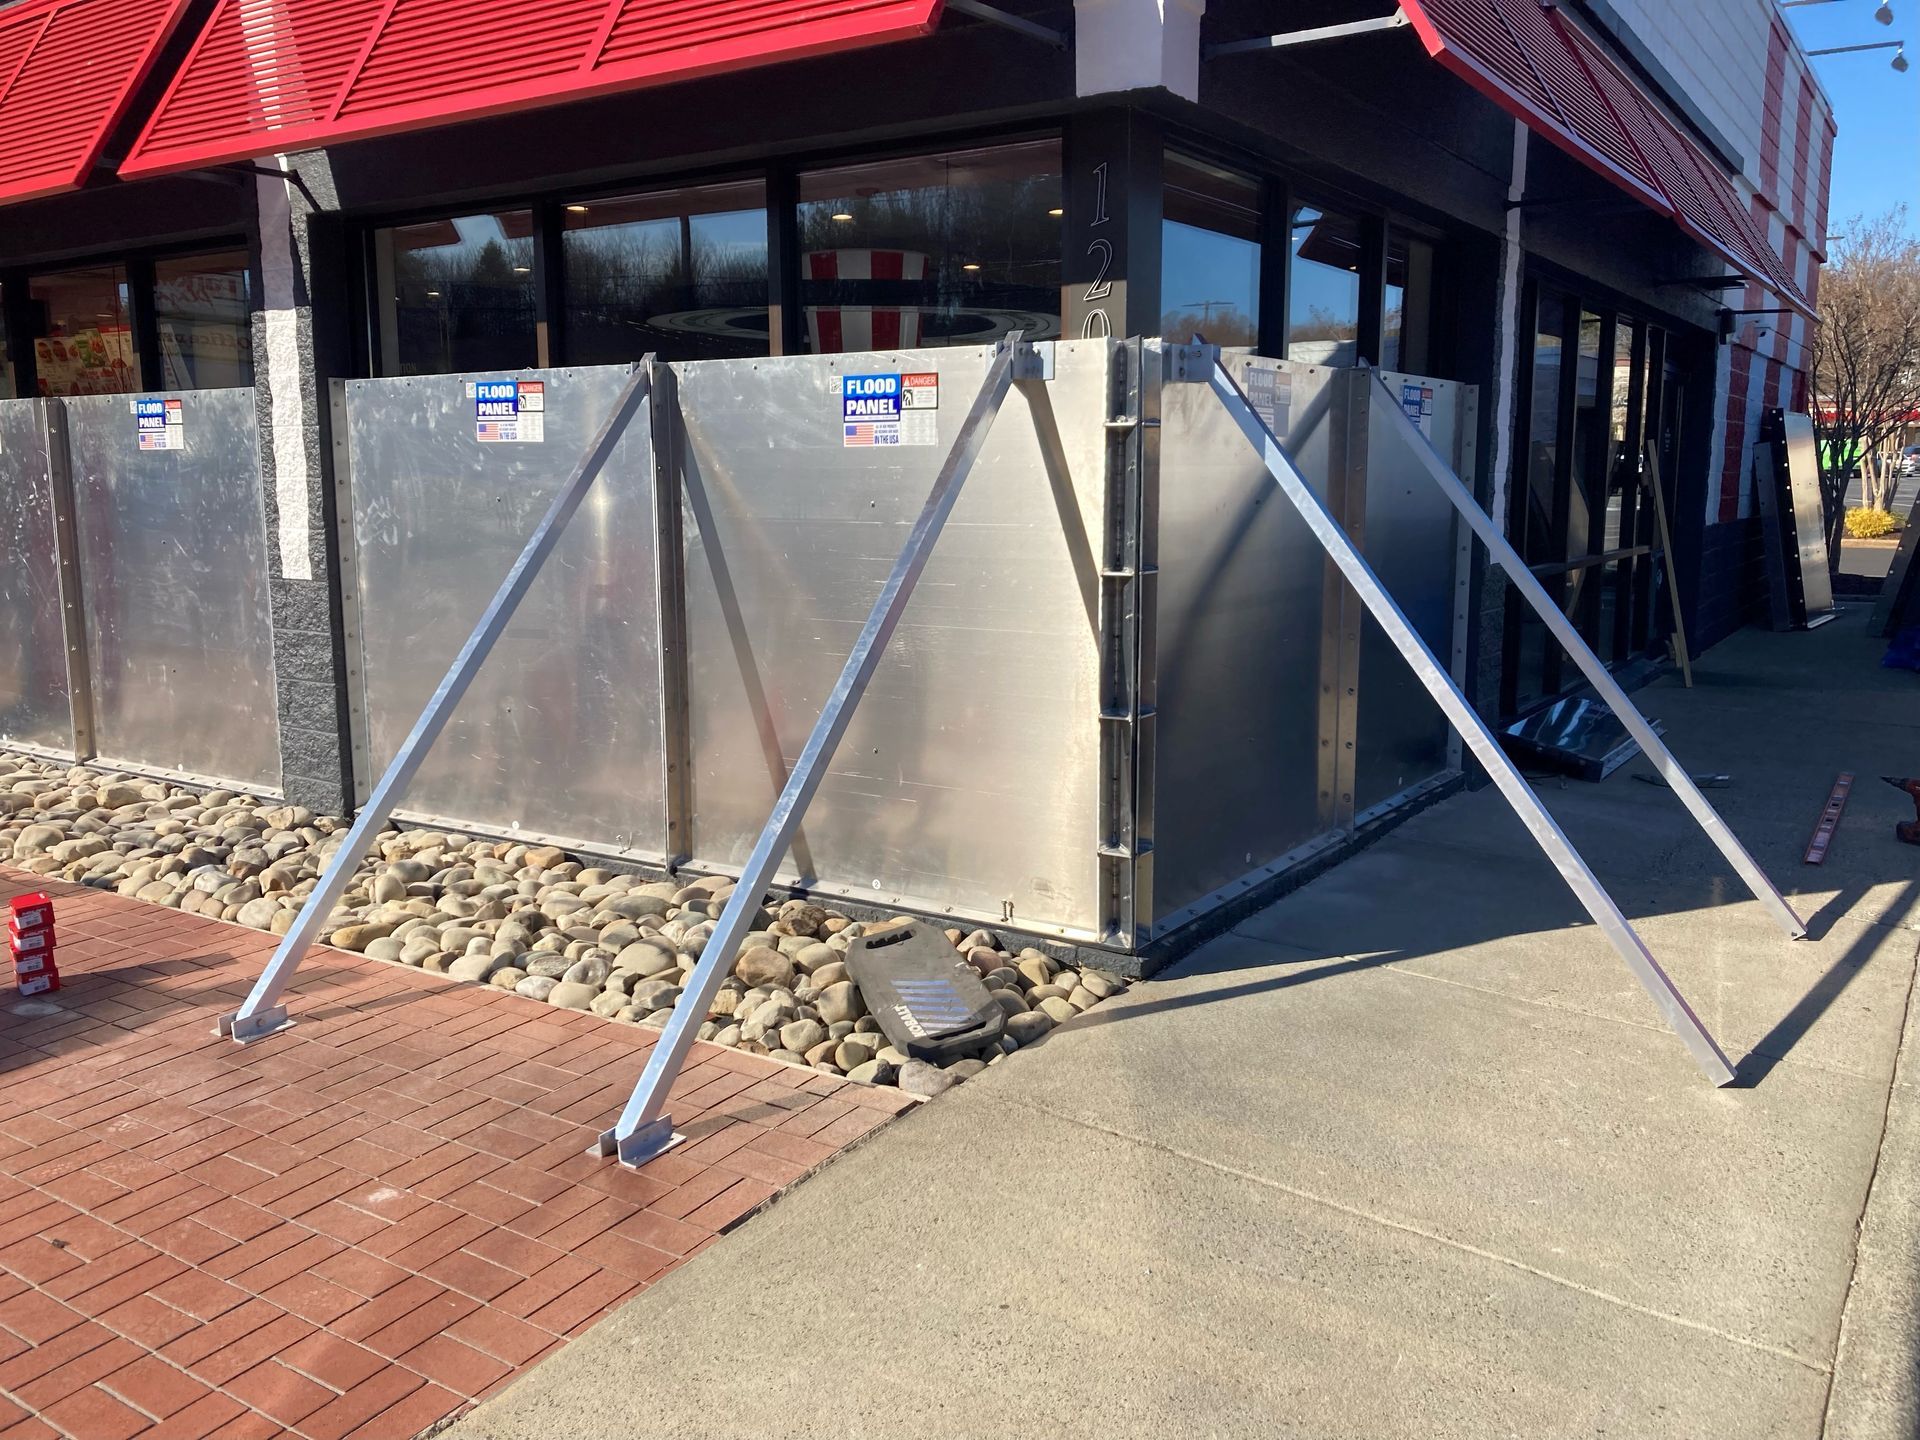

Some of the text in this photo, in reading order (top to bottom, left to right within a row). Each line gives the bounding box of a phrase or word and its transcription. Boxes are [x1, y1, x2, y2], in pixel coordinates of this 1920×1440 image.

[910, 376, 937, 386] DANGER
[1250, 372, 1273, 387] FLOOD
[479, 386, 514, 398] FLOOD
[847, 379, 896, 395] FLOOD
[1404, 388, 1420, 400] FLOOD
[138, 403, 162, 414] FLOOD
[479, 403, 515, 415] PANEL
[847, 400, 897, 415] PANEL
[139, 417, 164, 428] PANEL
[880, 435, 889, 444] THE
[889, 435, 899, 444] USA
[893, 1003, 928, 1038] KOBALT
